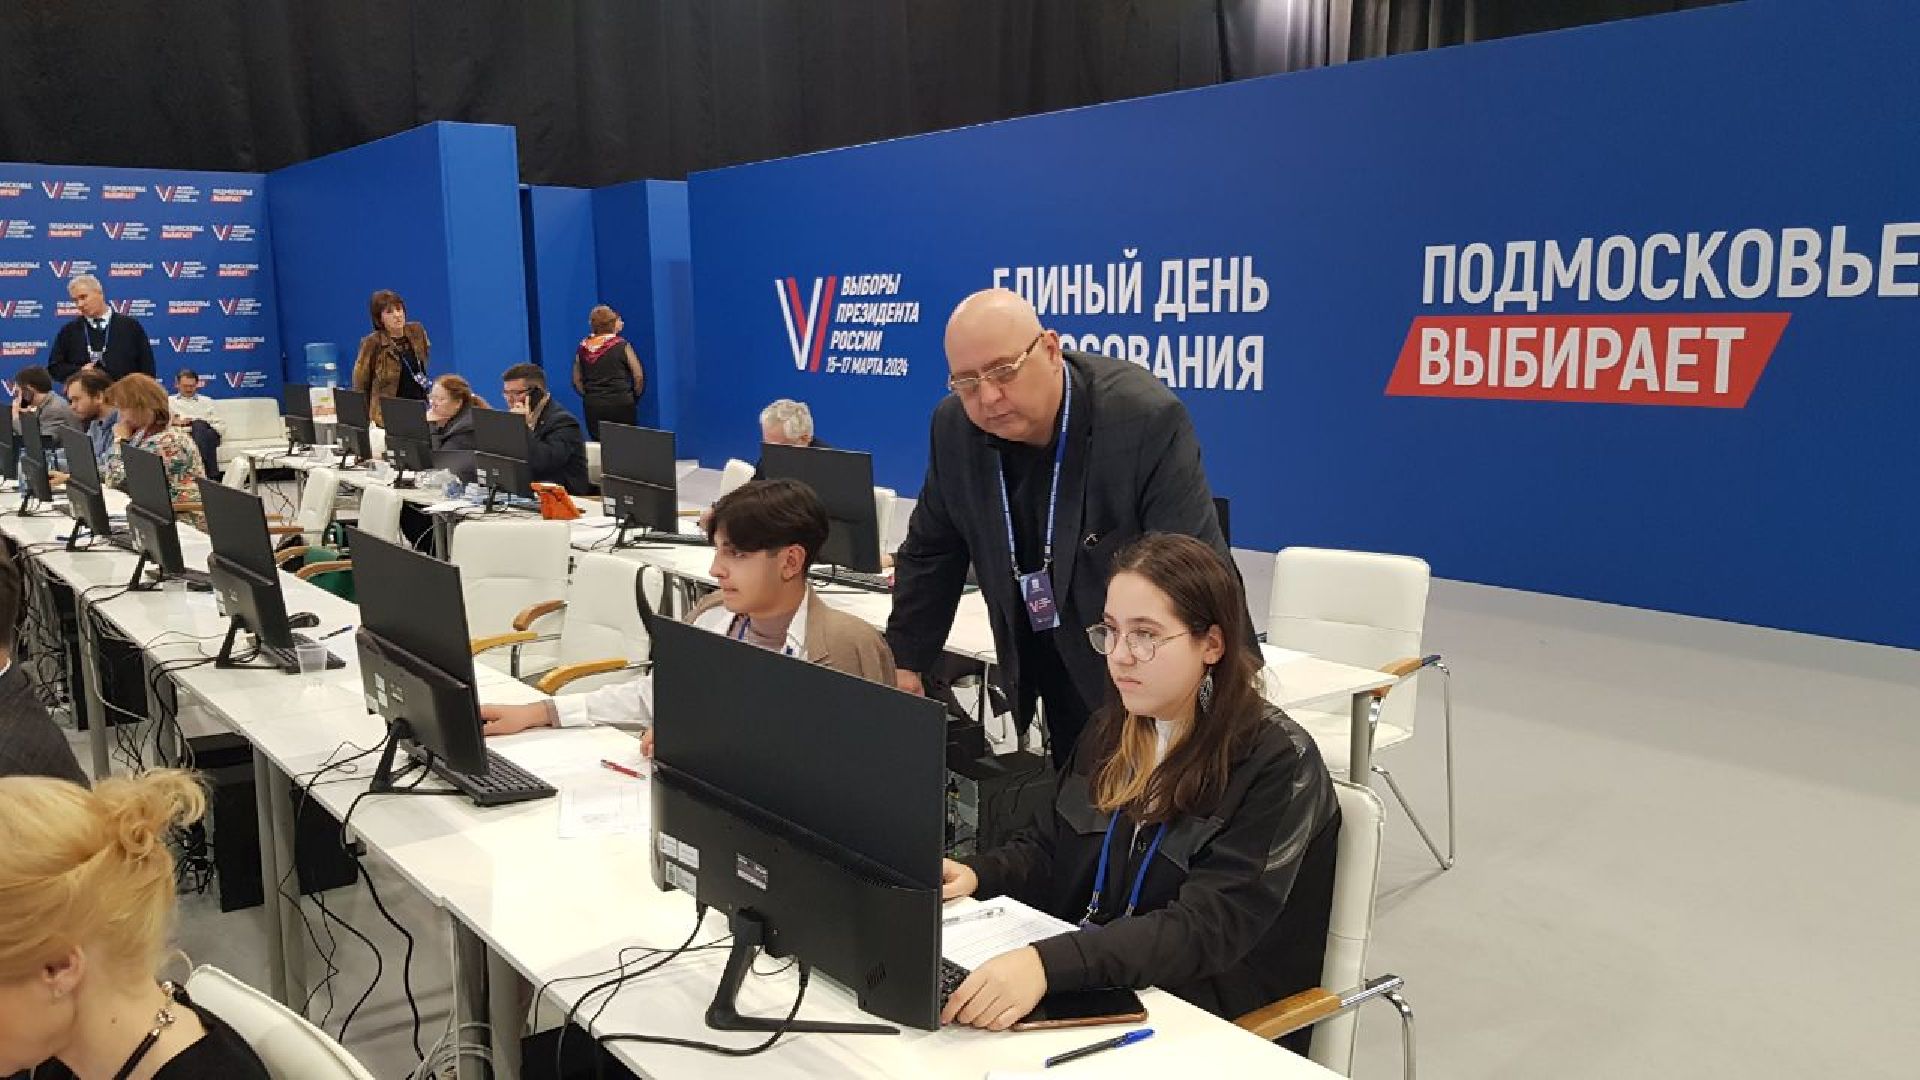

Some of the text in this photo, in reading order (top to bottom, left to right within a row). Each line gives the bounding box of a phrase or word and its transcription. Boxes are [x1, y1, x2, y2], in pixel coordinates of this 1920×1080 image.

[840, 273, 901, 296] ВЫБОРЫ
[1154, 256, 1269, 322] ДЕНЬ
[1422, 222, 1920, 312] ПОДМОСКОВЬЕ
[829, 330, 883, 352] РОССИИ
[834, 301, 920, 326] ПРЕЗИДЕНТА
[1058, 333, 1264, 390] ВАНИЯ
[1418, 326, 1746, 394] ВЫБИРАЕТ
